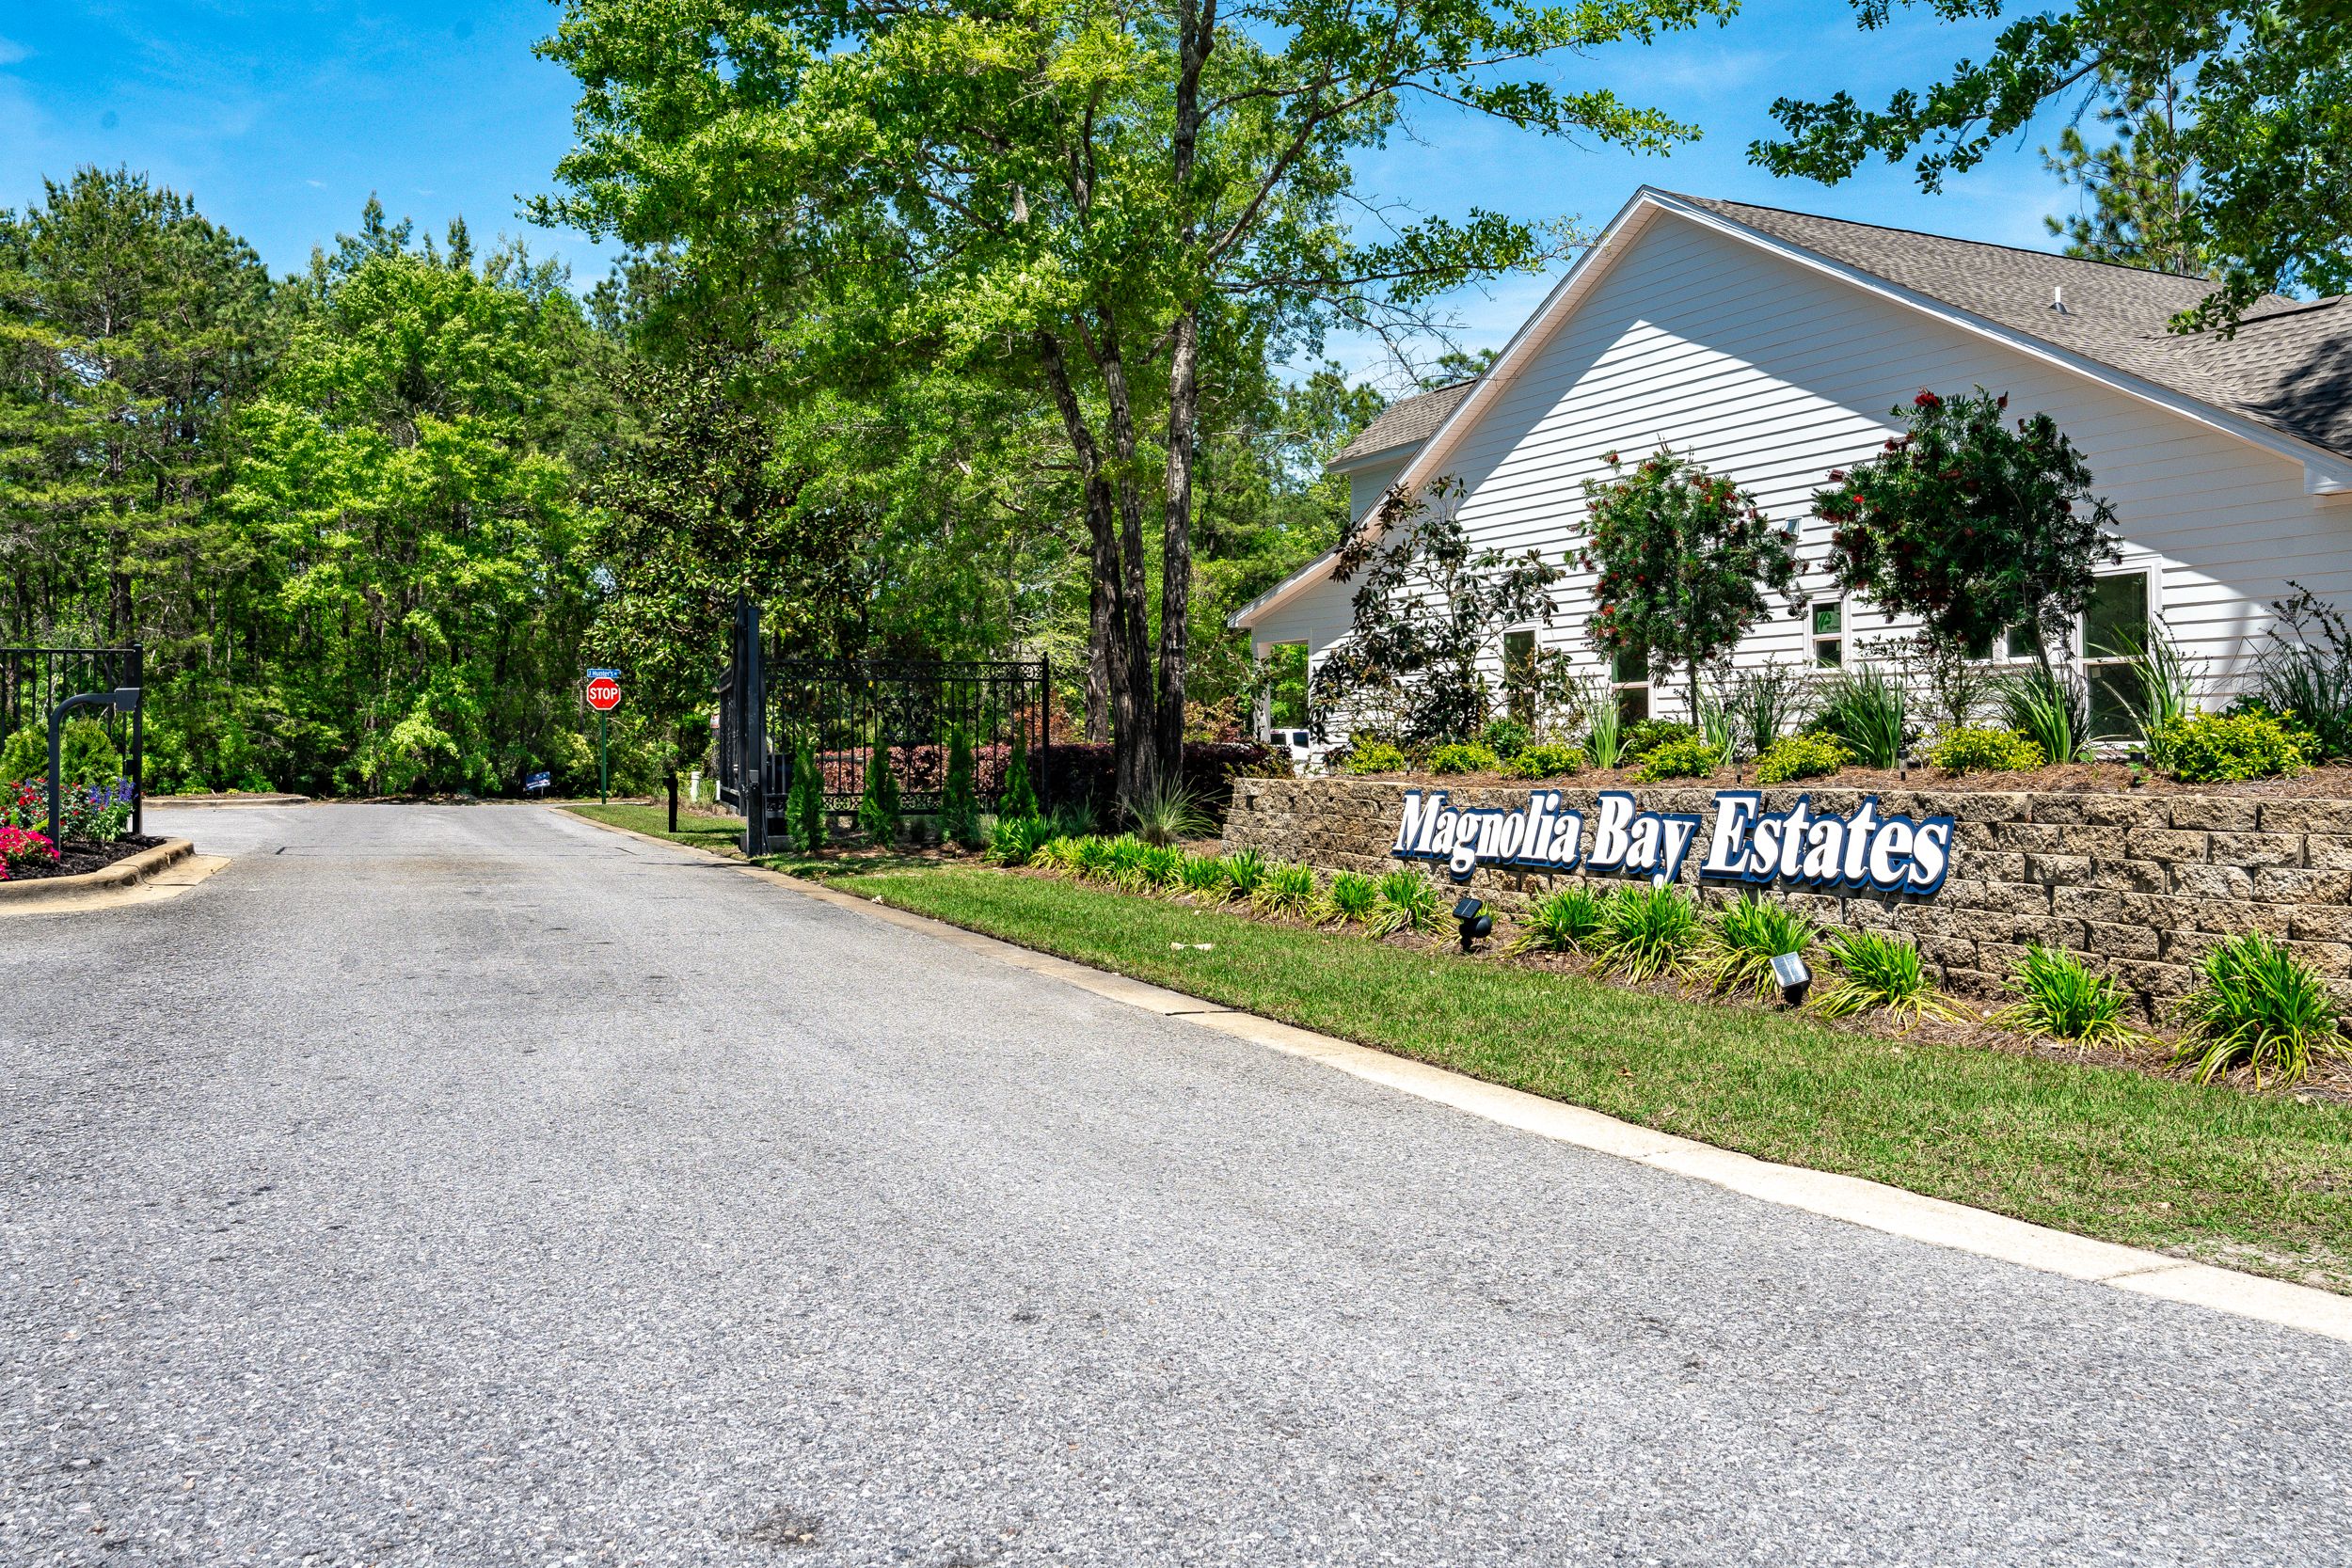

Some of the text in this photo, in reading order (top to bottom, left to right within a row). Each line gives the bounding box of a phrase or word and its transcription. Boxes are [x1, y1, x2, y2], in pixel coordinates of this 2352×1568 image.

[589, 688, 618, 700] STOP
[1391, 793, 1950, 890] Magnolia Bay Estates
